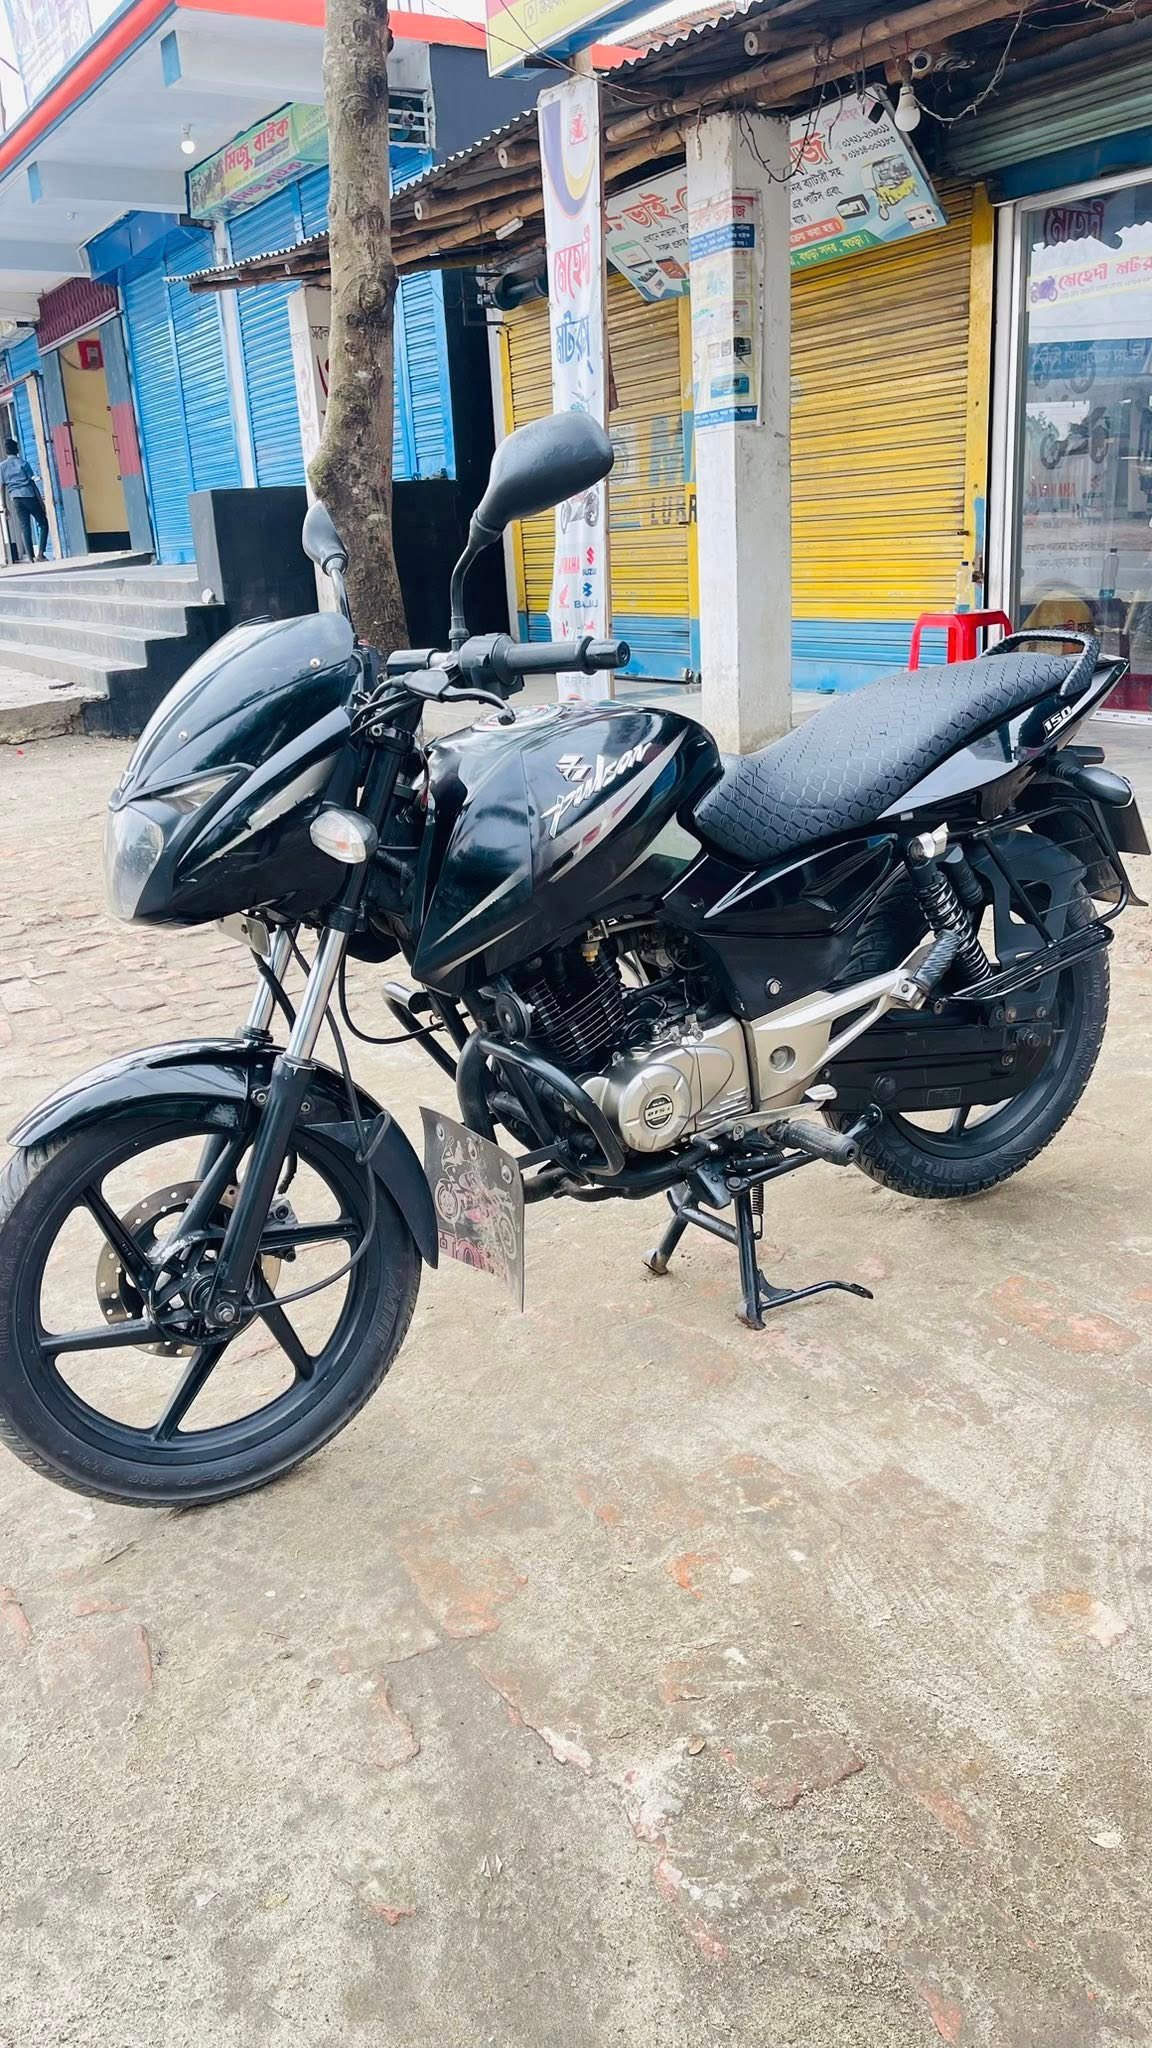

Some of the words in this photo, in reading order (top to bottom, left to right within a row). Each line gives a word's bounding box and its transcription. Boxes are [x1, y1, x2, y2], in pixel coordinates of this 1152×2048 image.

[554, 224, 591, 305] মেহেদী
[1059, 263, 1109, 290] মেহেদী
[1044, 705, 1072, 731] 150
